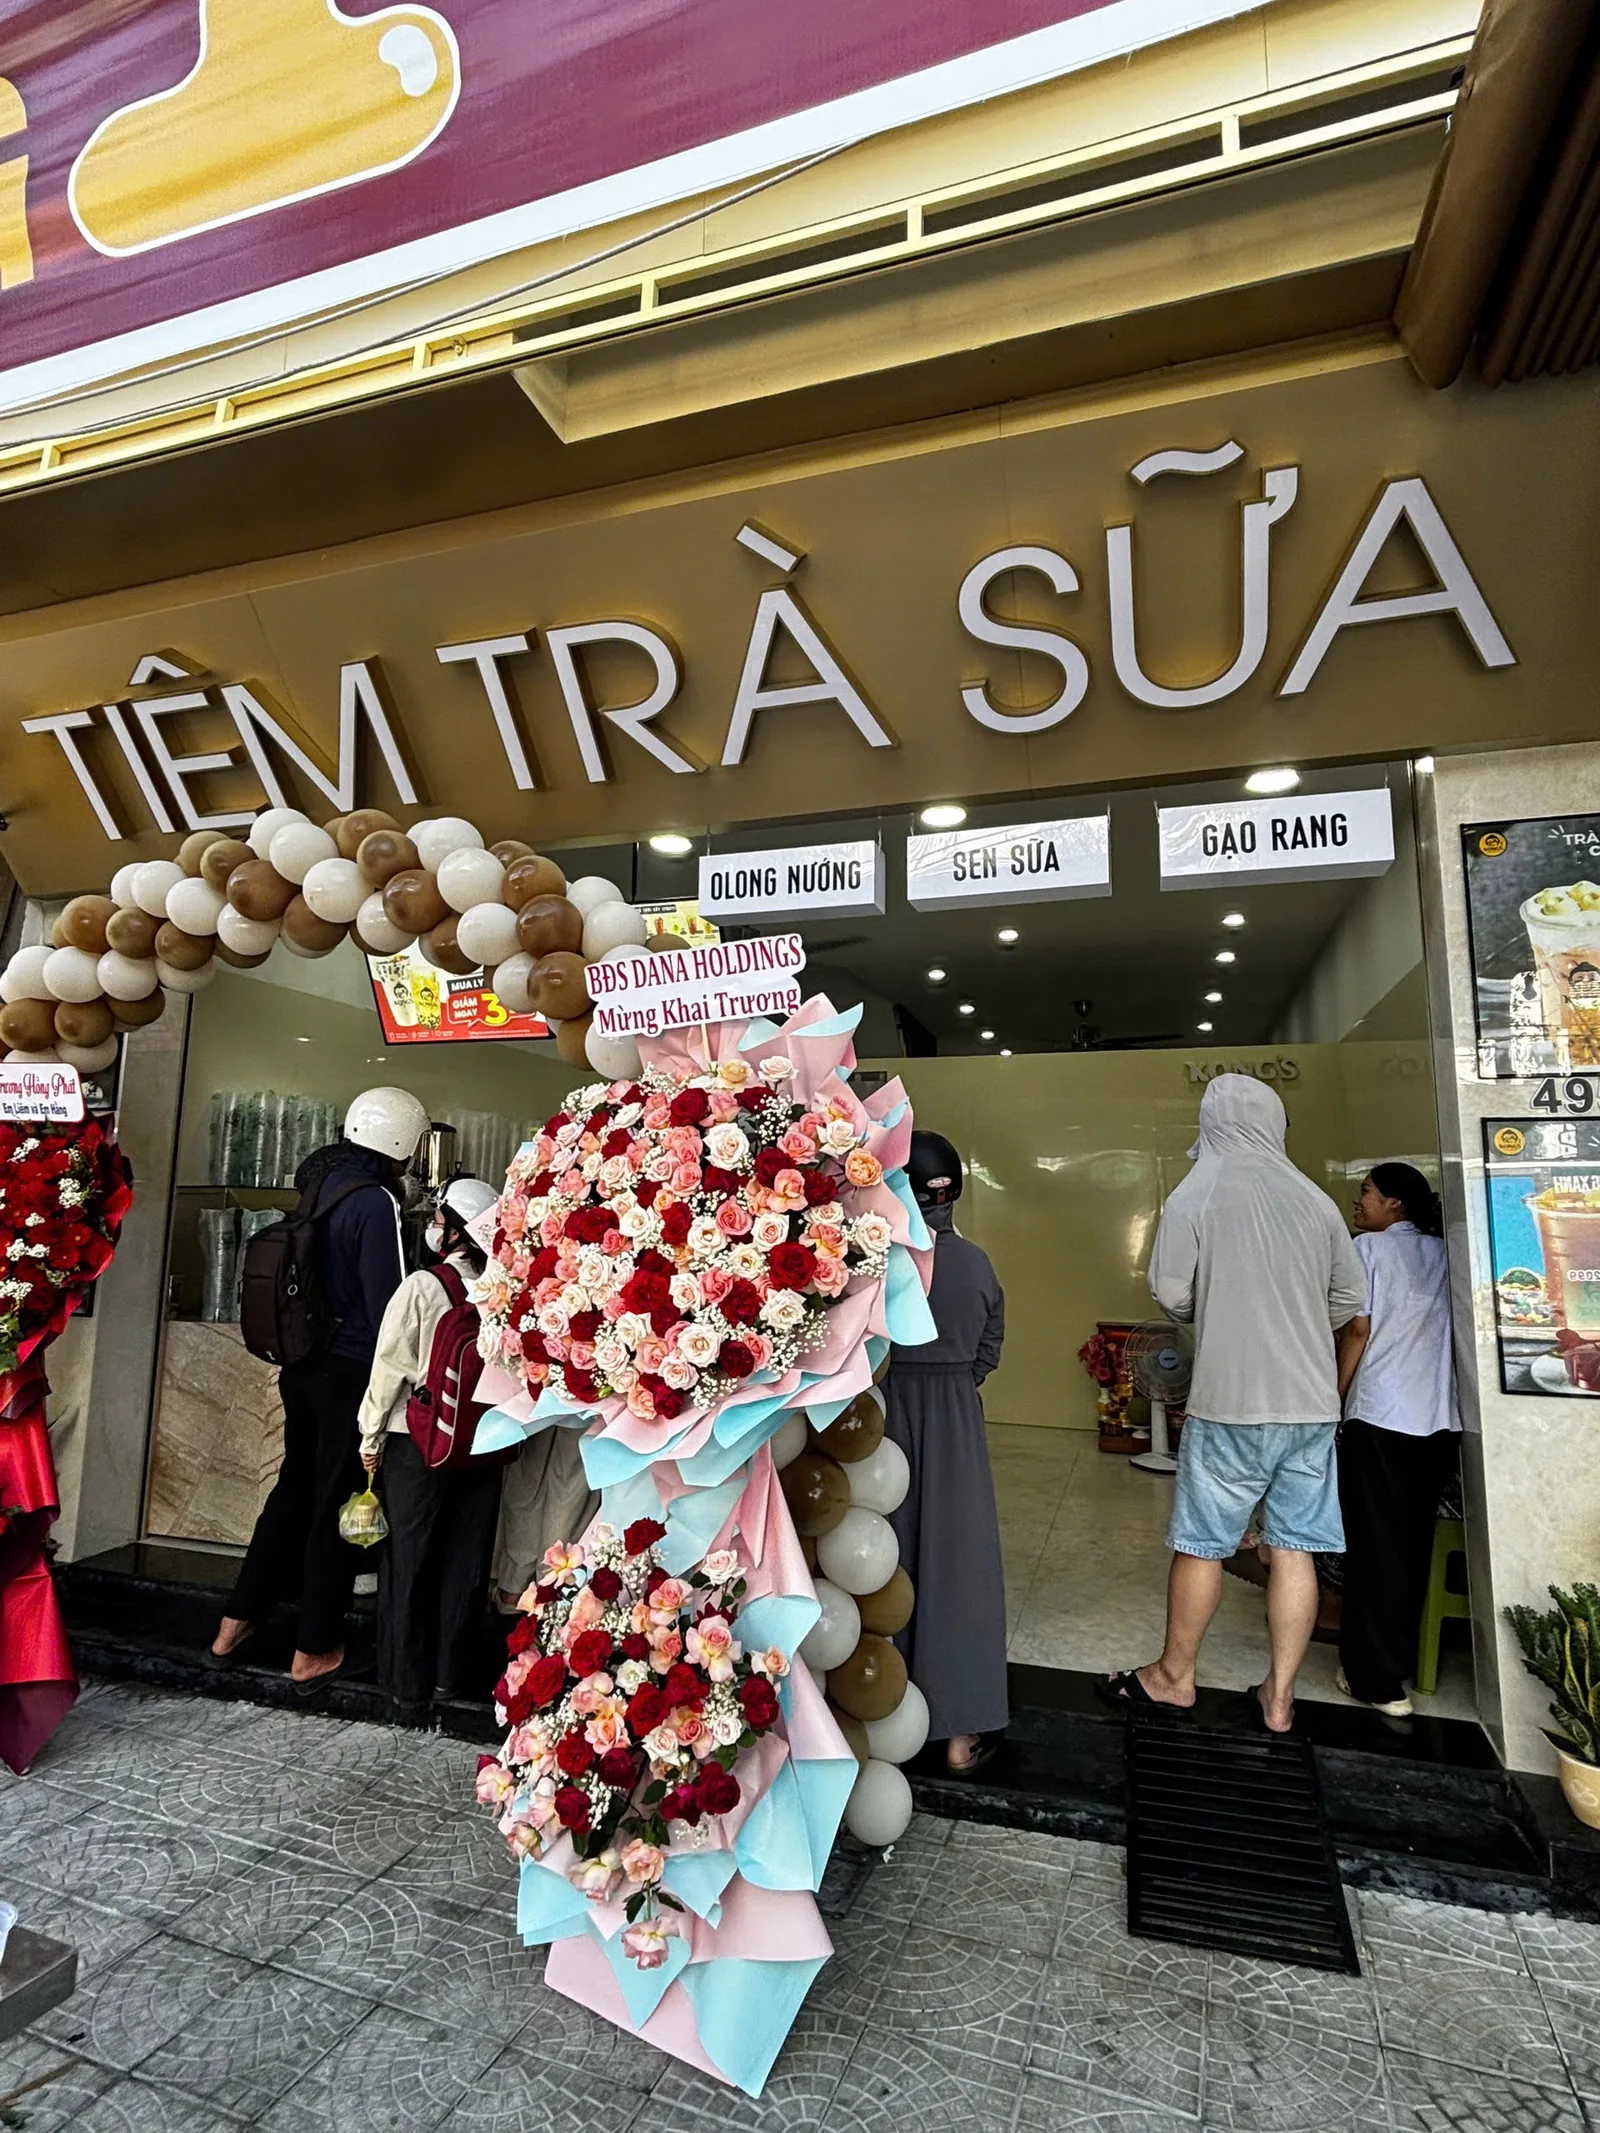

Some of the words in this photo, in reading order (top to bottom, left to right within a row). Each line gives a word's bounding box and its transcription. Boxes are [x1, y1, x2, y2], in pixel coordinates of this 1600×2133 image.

[435, 522, 893, 790] TRÀ
[956, 439, 1517, 735] SỮA
[1202, 820, 1257, 860] GẠO
[1271, 813, 1348, 851] RANG
[1562, 830, 1600, 845] TRÀ
[711, 867, 777, 900] OLONG
[788, 857, 861, 894] NƯỚNG
[953, 848, 997, 881] SEN
[1010, 838, 1060, 875] SỮA
[451, 981, 473, 991] MUA
[474, 978, 485, 988] LY
[587, 961, 628, 995] BĐS
[631, 951, 689, 988] DANA
[693, 935, 801, 980] HOLDINGS
[452, 995, 478, 1009] GIẢM
[454, 1008, 478, 1020] NGAY
[481, 993, 507, 1024] 3
[597, 1005, 656, 1035] Mừng
[661, 994, 711, 1025] Khai
[714, 988, 800, 1016] Trương
[1531, 1077, 1600, 1115] 49
